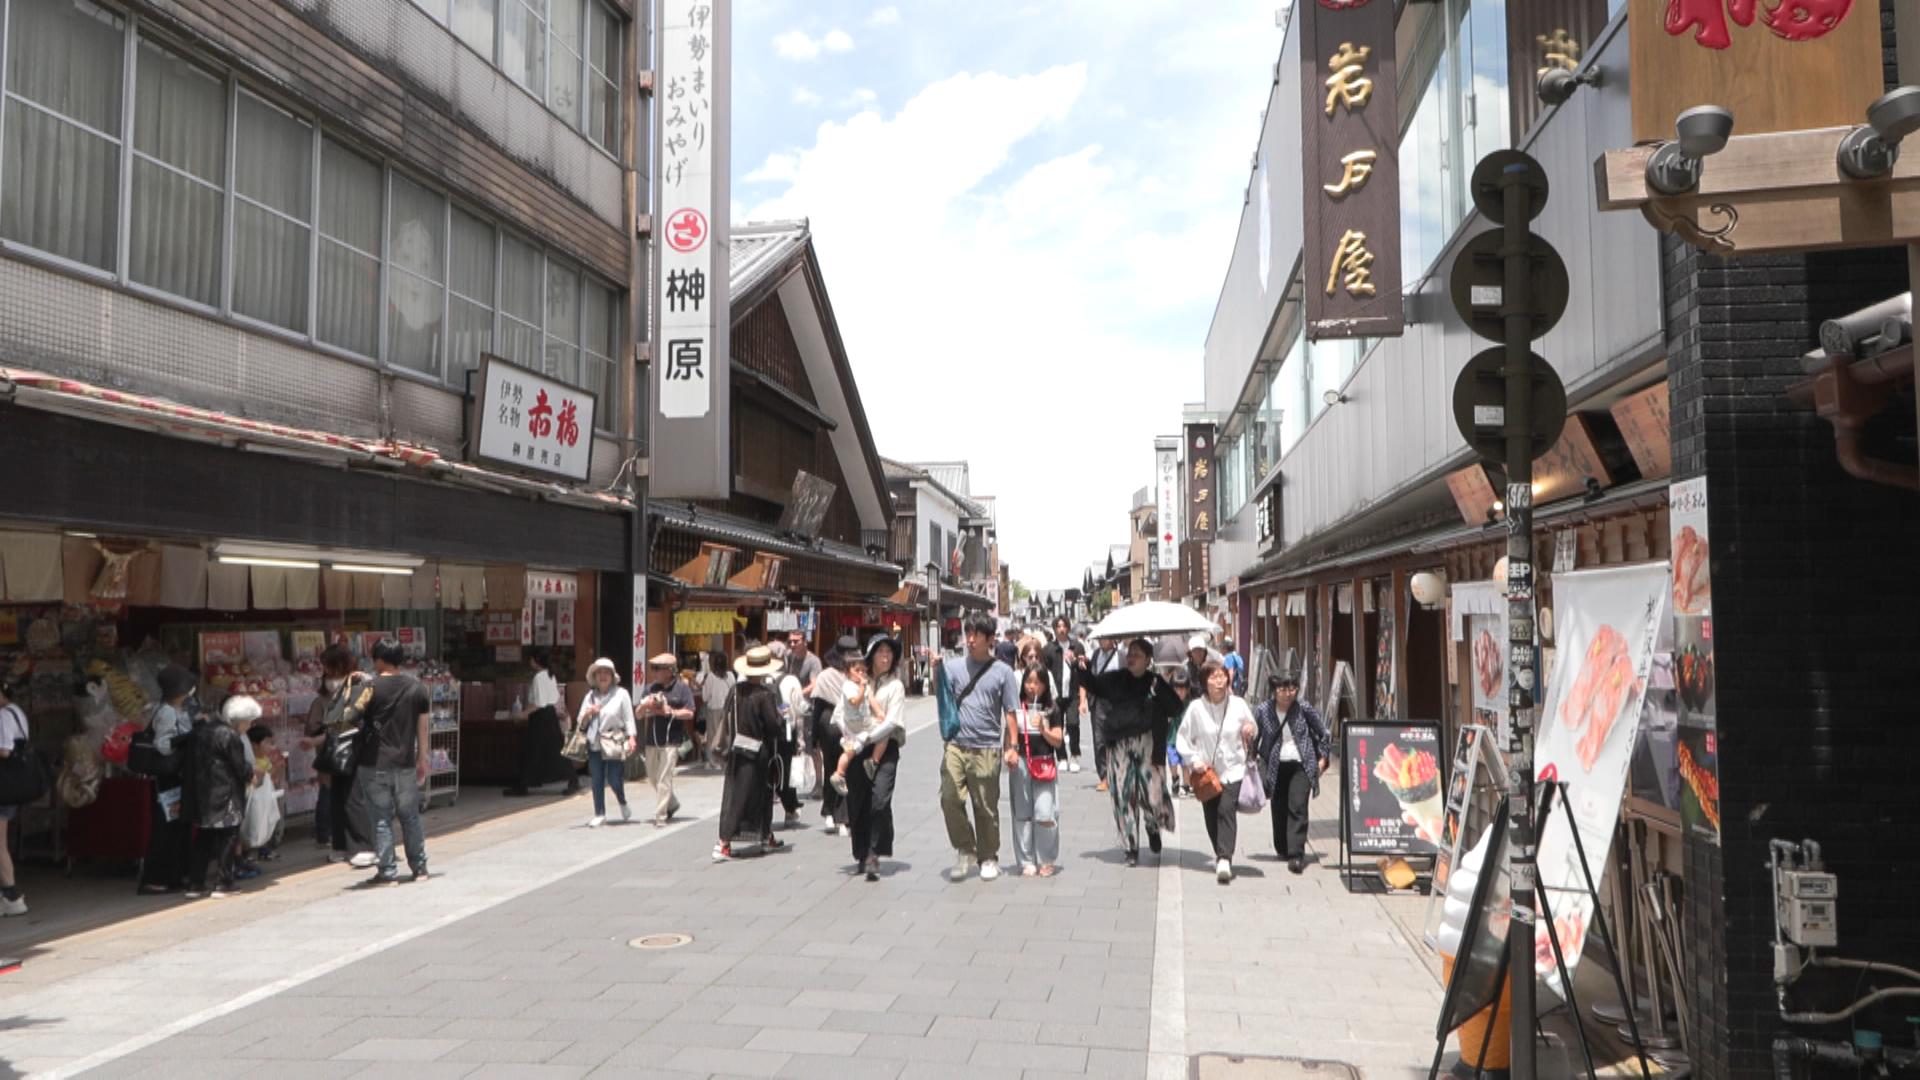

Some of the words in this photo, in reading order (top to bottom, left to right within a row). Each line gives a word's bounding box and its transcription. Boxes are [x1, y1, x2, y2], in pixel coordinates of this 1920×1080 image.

[665, 76, 689, 188] おみやげ
[1322, 41, 1377, 297] 岩戸屋
[665, 267, 706, 382] 榊原
[498, 403, 521, 429] 名物
[500, 379, 523, 406] 伊勢
[527, 387, 579, 448] 赤福
[1193, 457, 1210, 531] 岩戸屋
